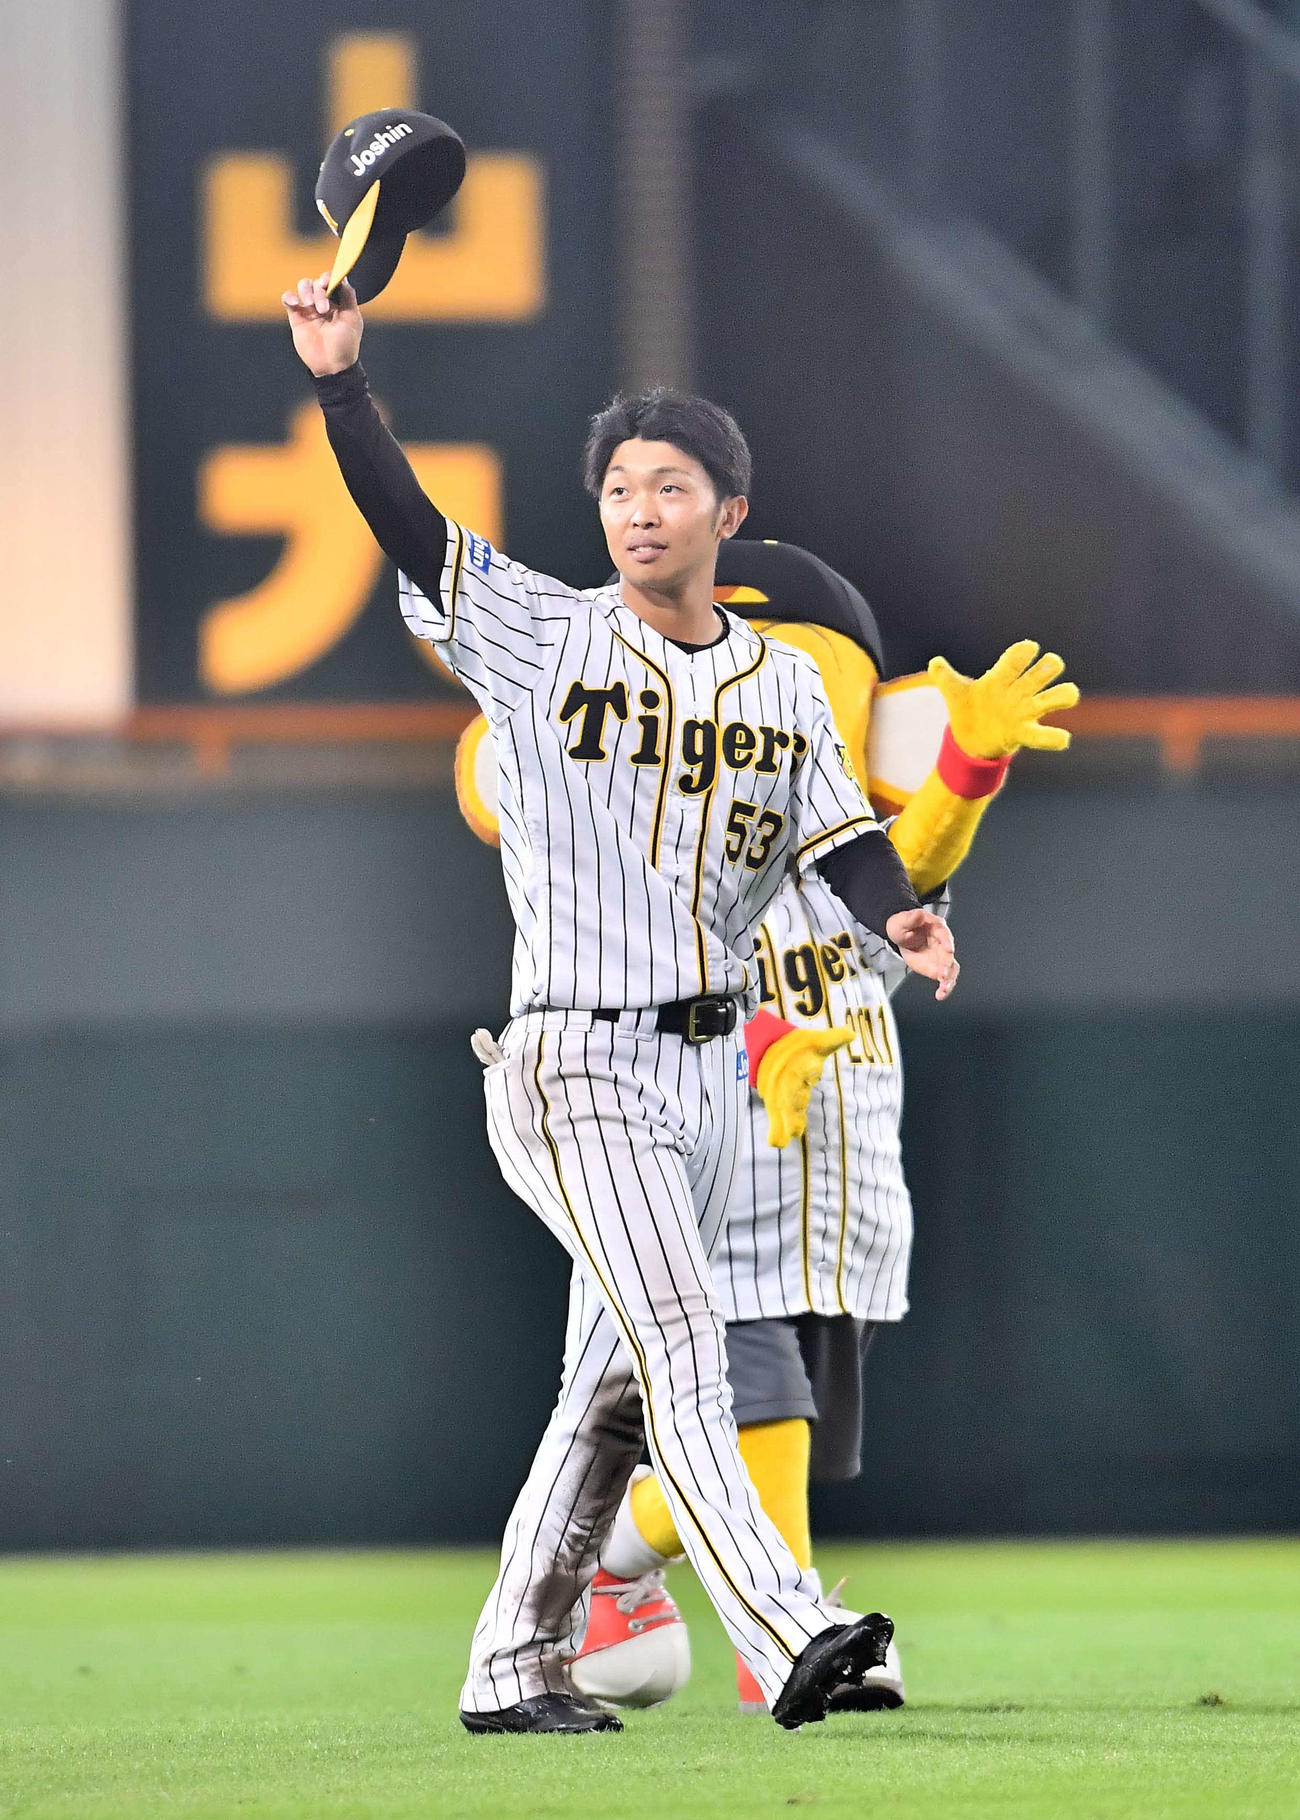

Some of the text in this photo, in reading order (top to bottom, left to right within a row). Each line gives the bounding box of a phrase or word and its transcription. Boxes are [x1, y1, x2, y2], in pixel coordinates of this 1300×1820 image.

[350, 123, 413, 177] Joshin
[724, 797, 786, 873] 53
[752, 930, 872, 1020] iger
